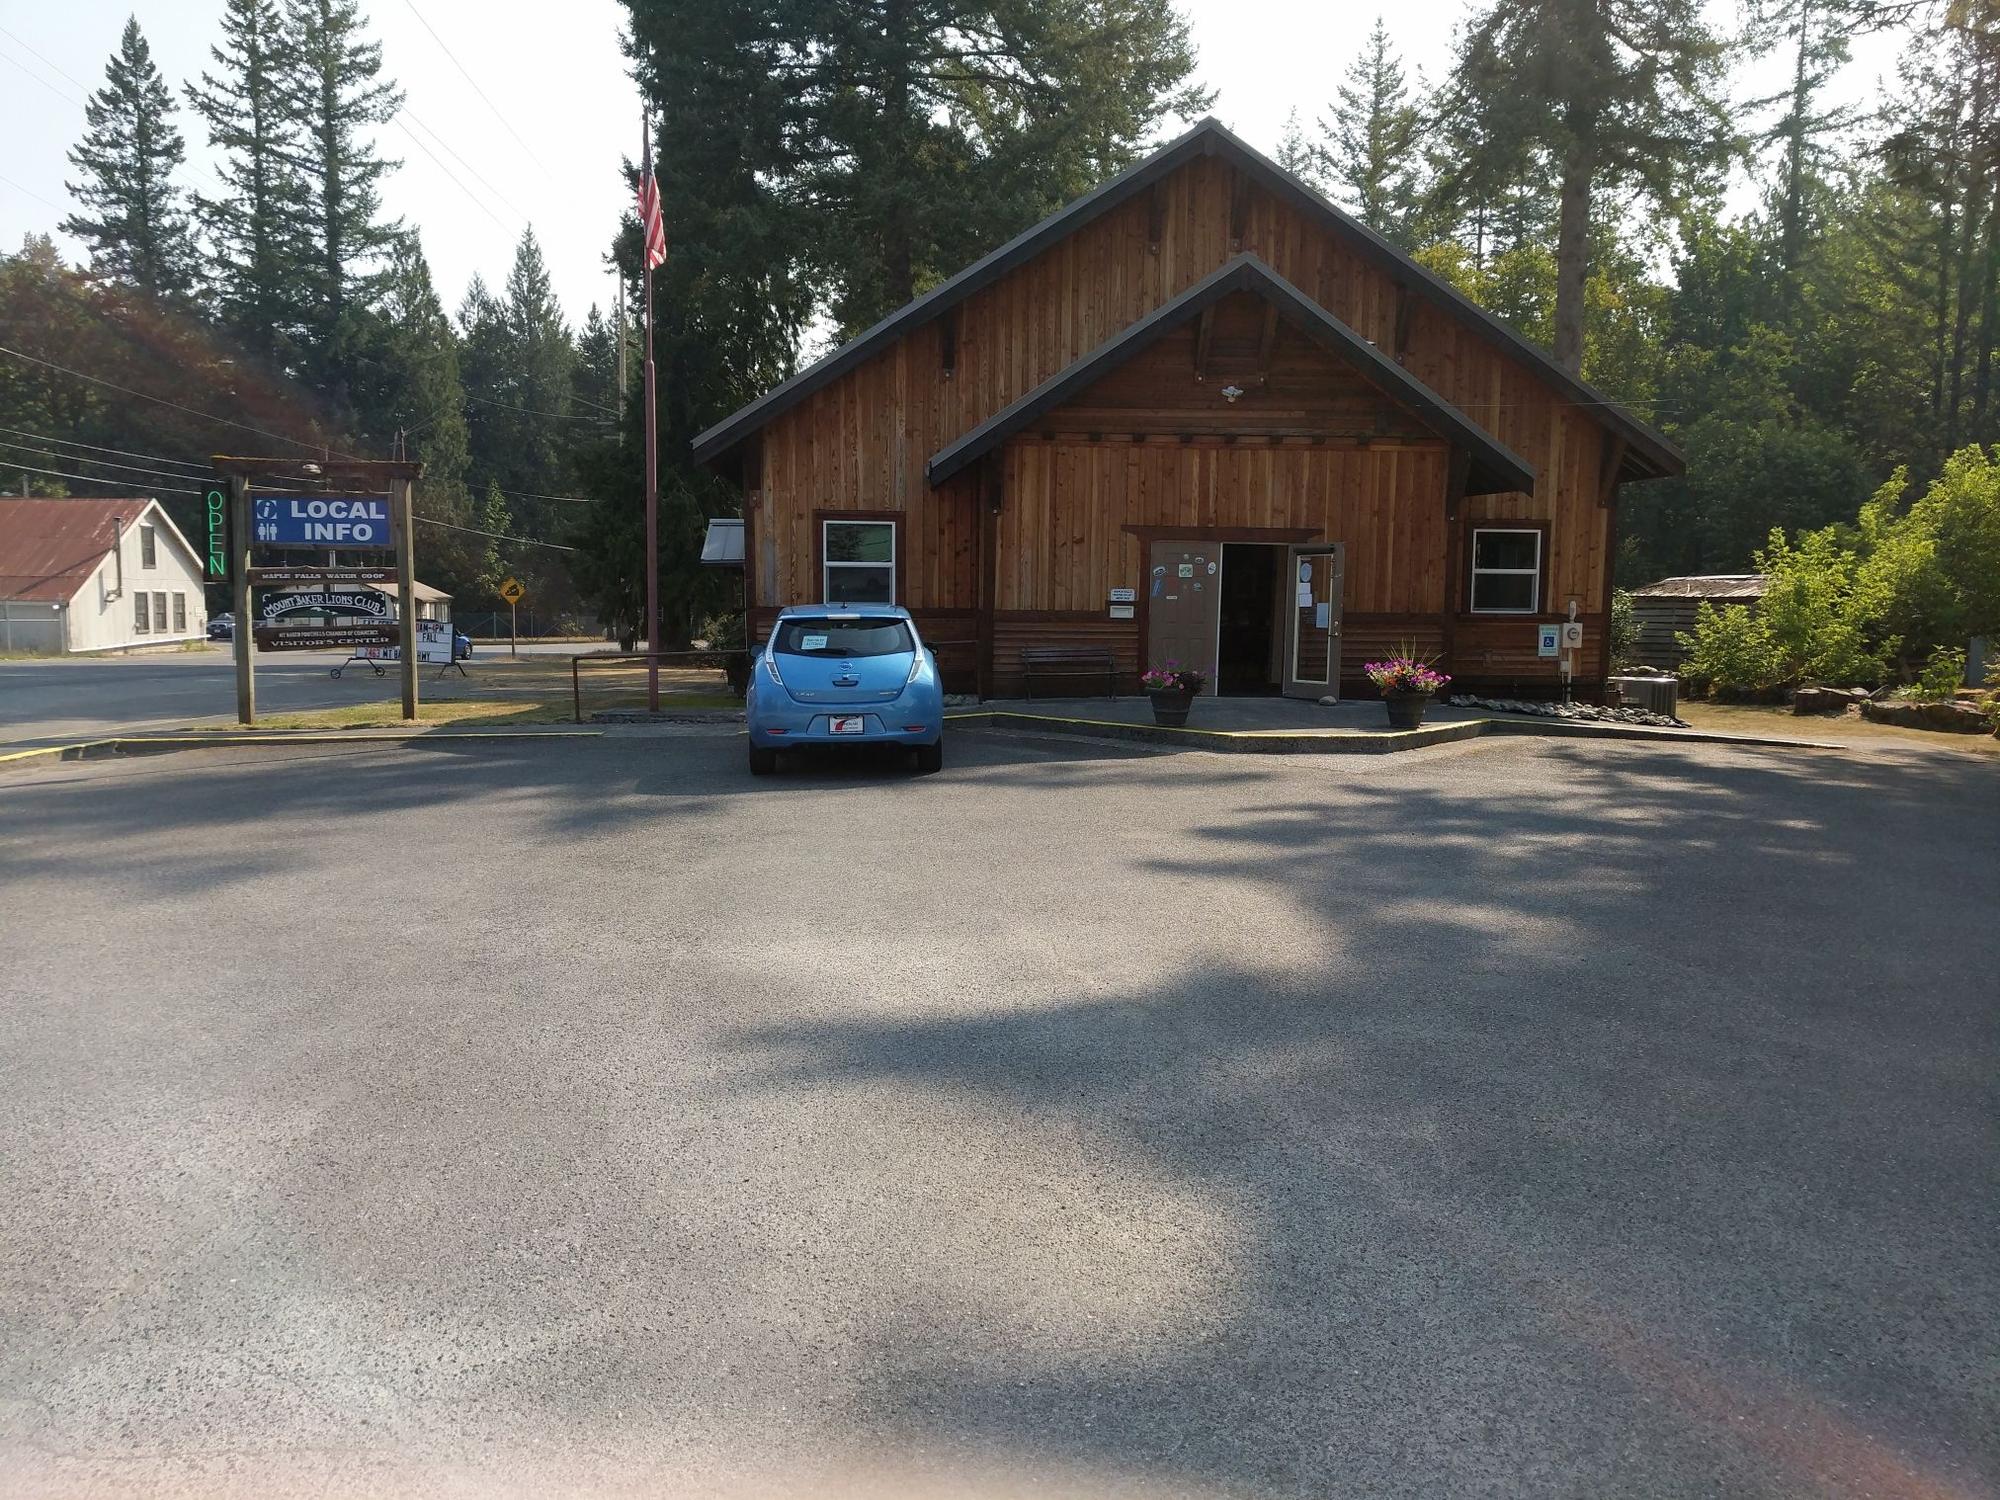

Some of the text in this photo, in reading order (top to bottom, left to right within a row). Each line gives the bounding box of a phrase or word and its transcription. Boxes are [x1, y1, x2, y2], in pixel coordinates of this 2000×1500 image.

[291, 500, 386, 519] LOCAL
[208, 490, 224, 575] OPEN
[304, 522, 373, 541] INFO
[265, 593, 381, 615] MOUNT BAKER LIONS CLUB
[423, 633, 437, 643] FALL
